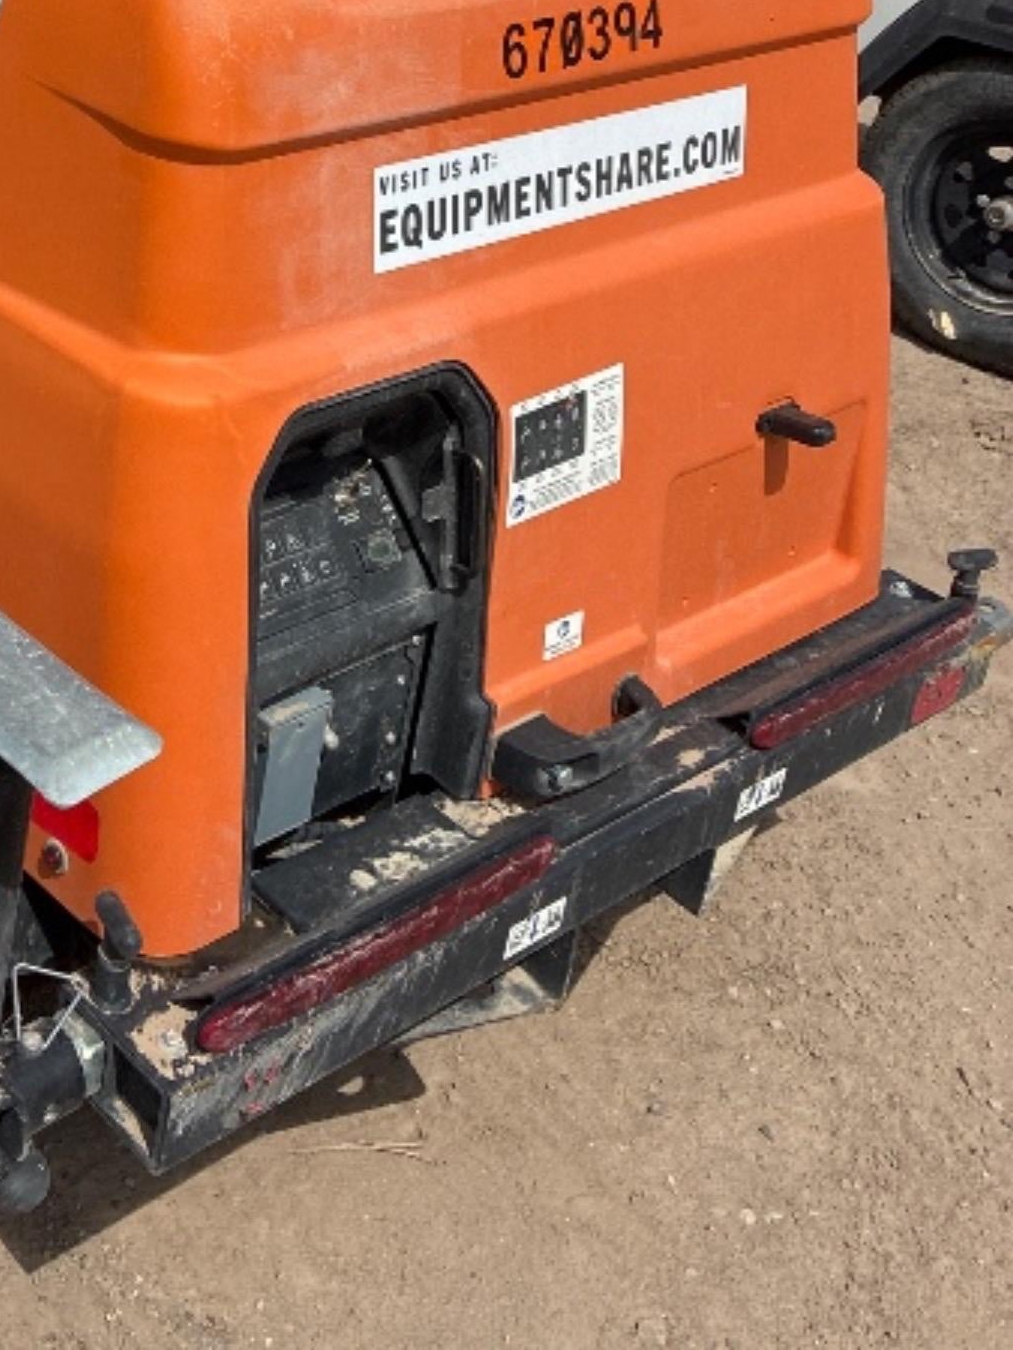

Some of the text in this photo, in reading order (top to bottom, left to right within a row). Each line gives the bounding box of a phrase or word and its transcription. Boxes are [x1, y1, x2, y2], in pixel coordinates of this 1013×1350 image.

[379, 152, 498, 196] VISIT US AT:
[379, 124, 741, 255] EQUIPMENTSHARE.COM
